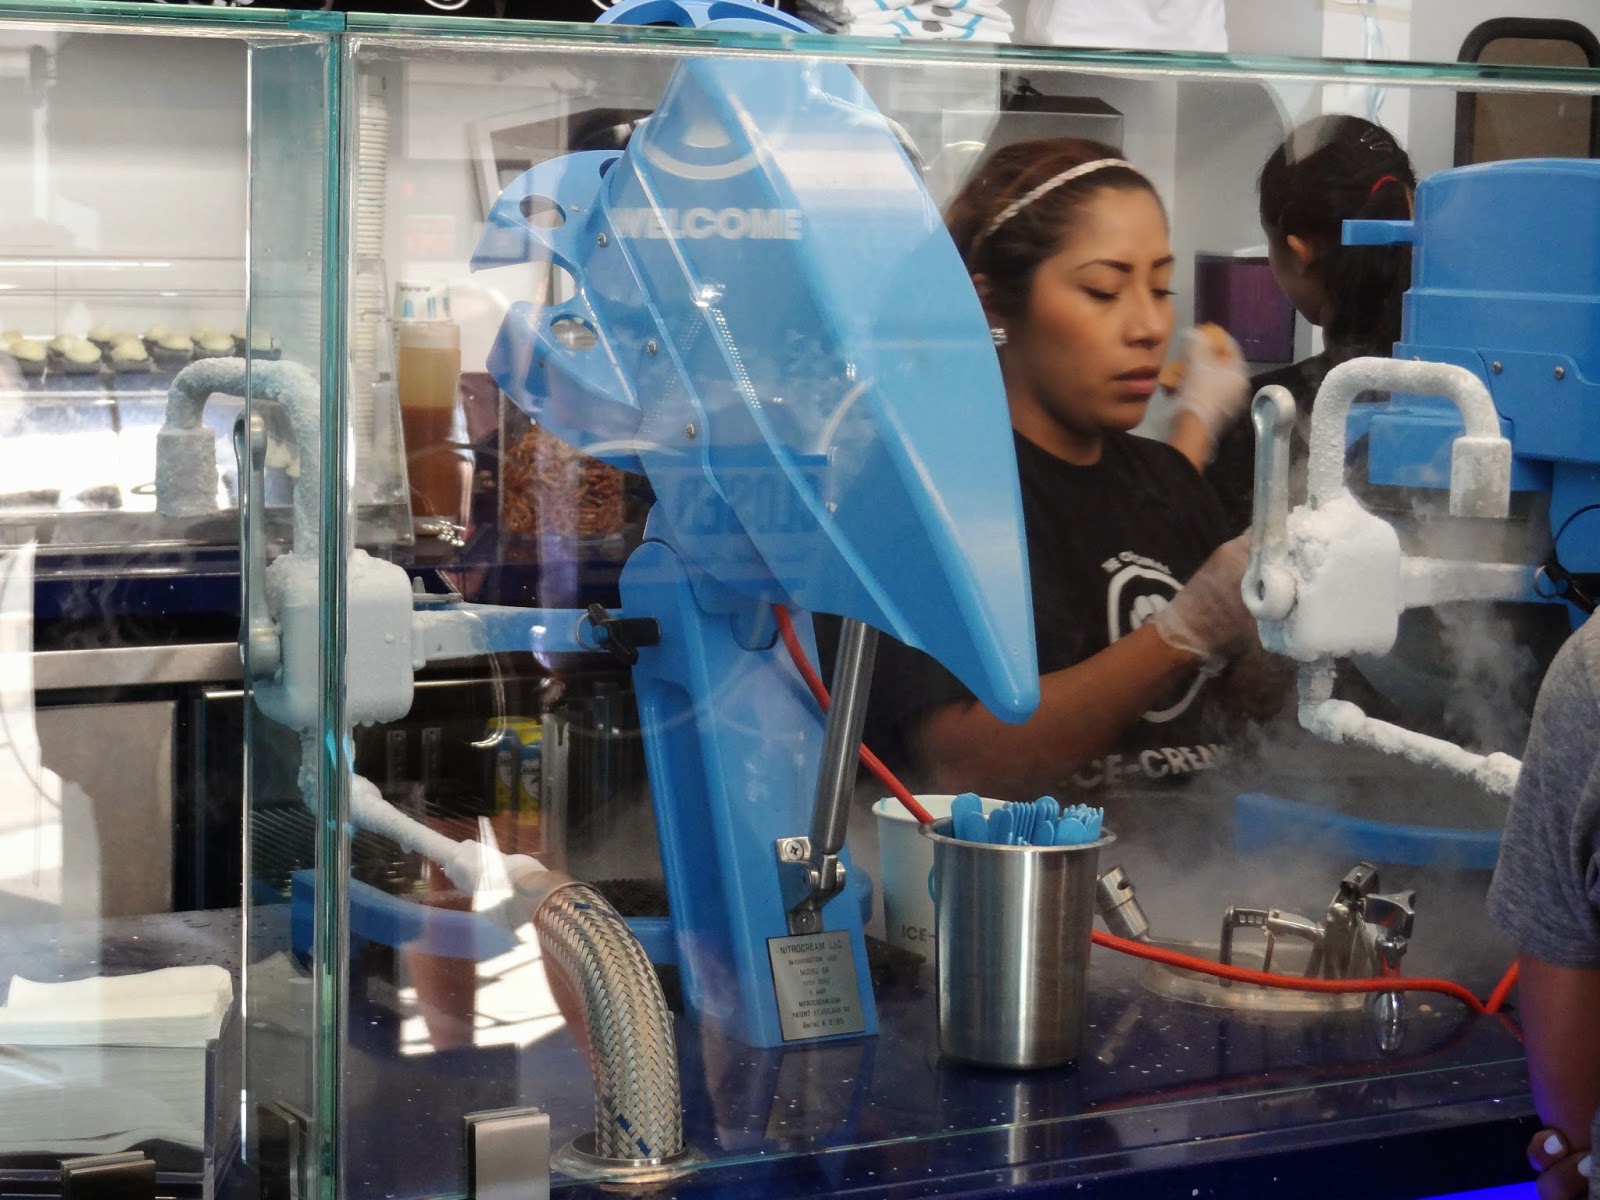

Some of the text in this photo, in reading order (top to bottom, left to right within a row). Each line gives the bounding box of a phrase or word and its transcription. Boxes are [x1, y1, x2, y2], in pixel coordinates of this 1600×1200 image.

[611, 207, 801, 240] WELCOME
[780, 940, 842, 954] NITROCREAM LLC
[792, 1010, 810, 1018] PATENT
